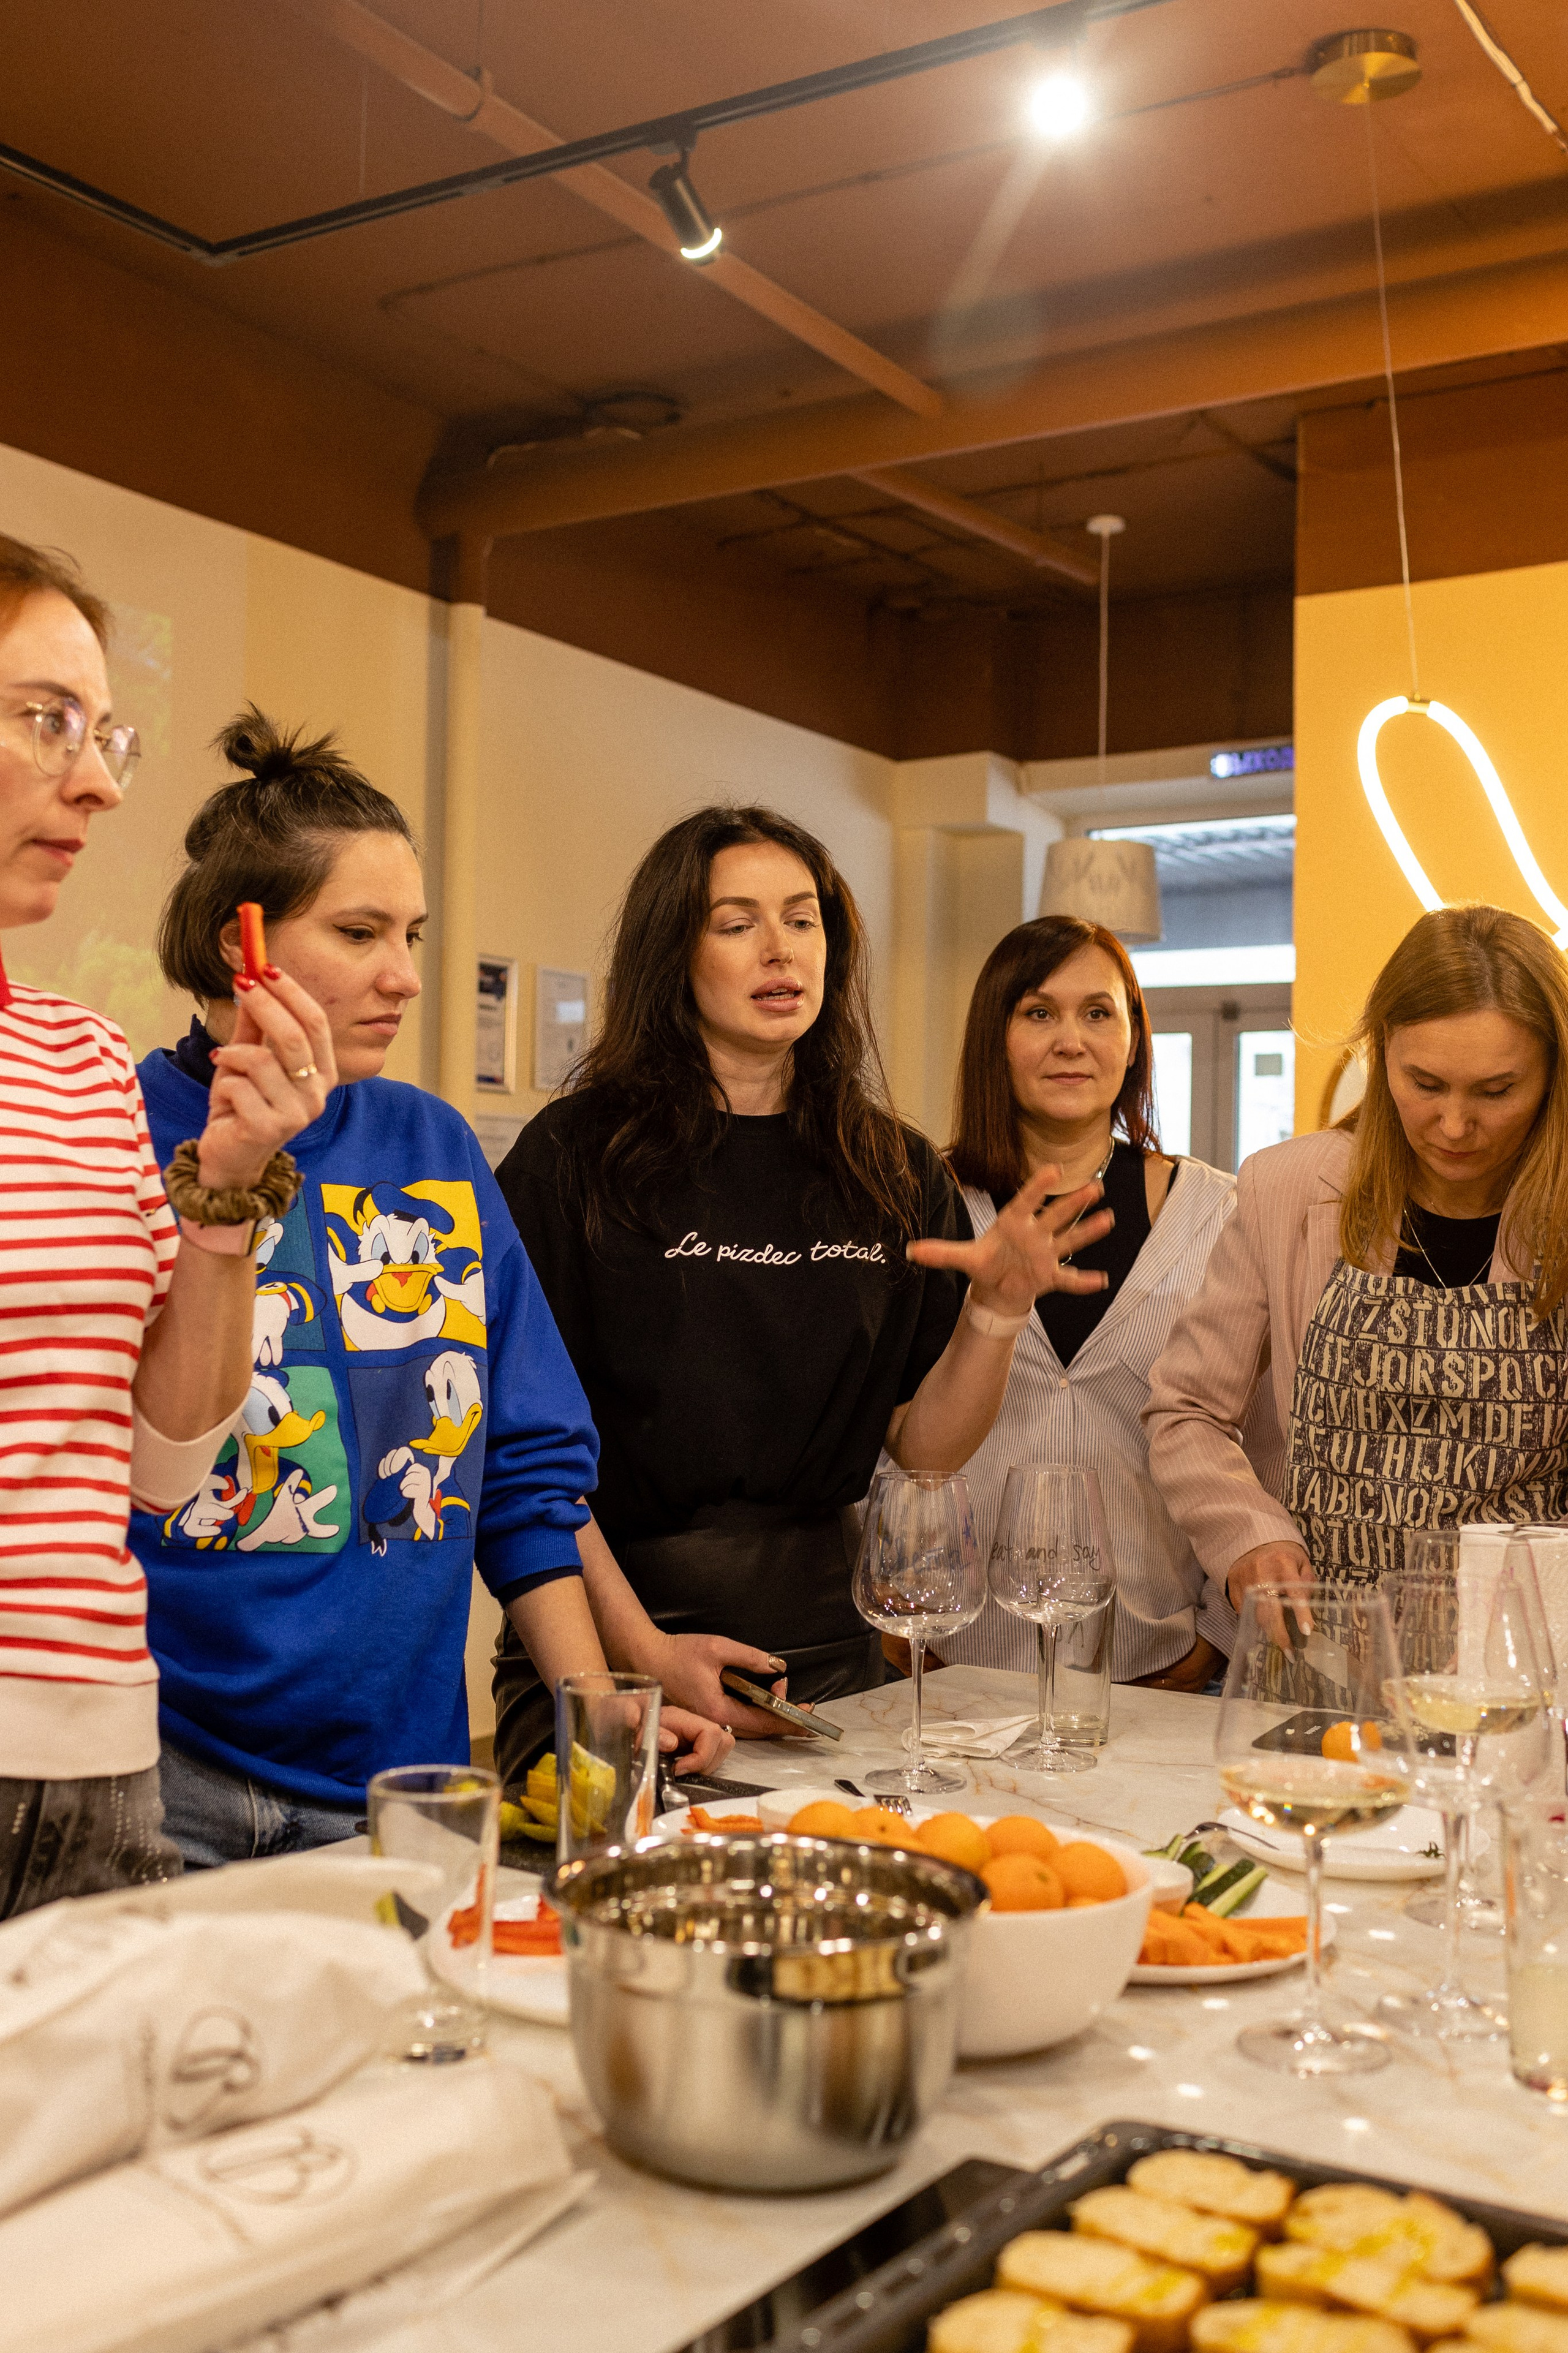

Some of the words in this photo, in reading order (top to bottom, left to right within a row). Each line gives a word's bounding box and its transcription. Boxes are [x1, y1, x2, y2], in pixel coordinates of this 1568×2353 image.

[665, 1231, 712, 1259] Le
[716, 1244, 802, 1266] pizdec
[810, 1240, 886, 1264] total.
[990, 1531, 1013, 1562] eat
[1025, 1535, 1058, 1563] and
[1072, 1544, 1101, 1571] say
